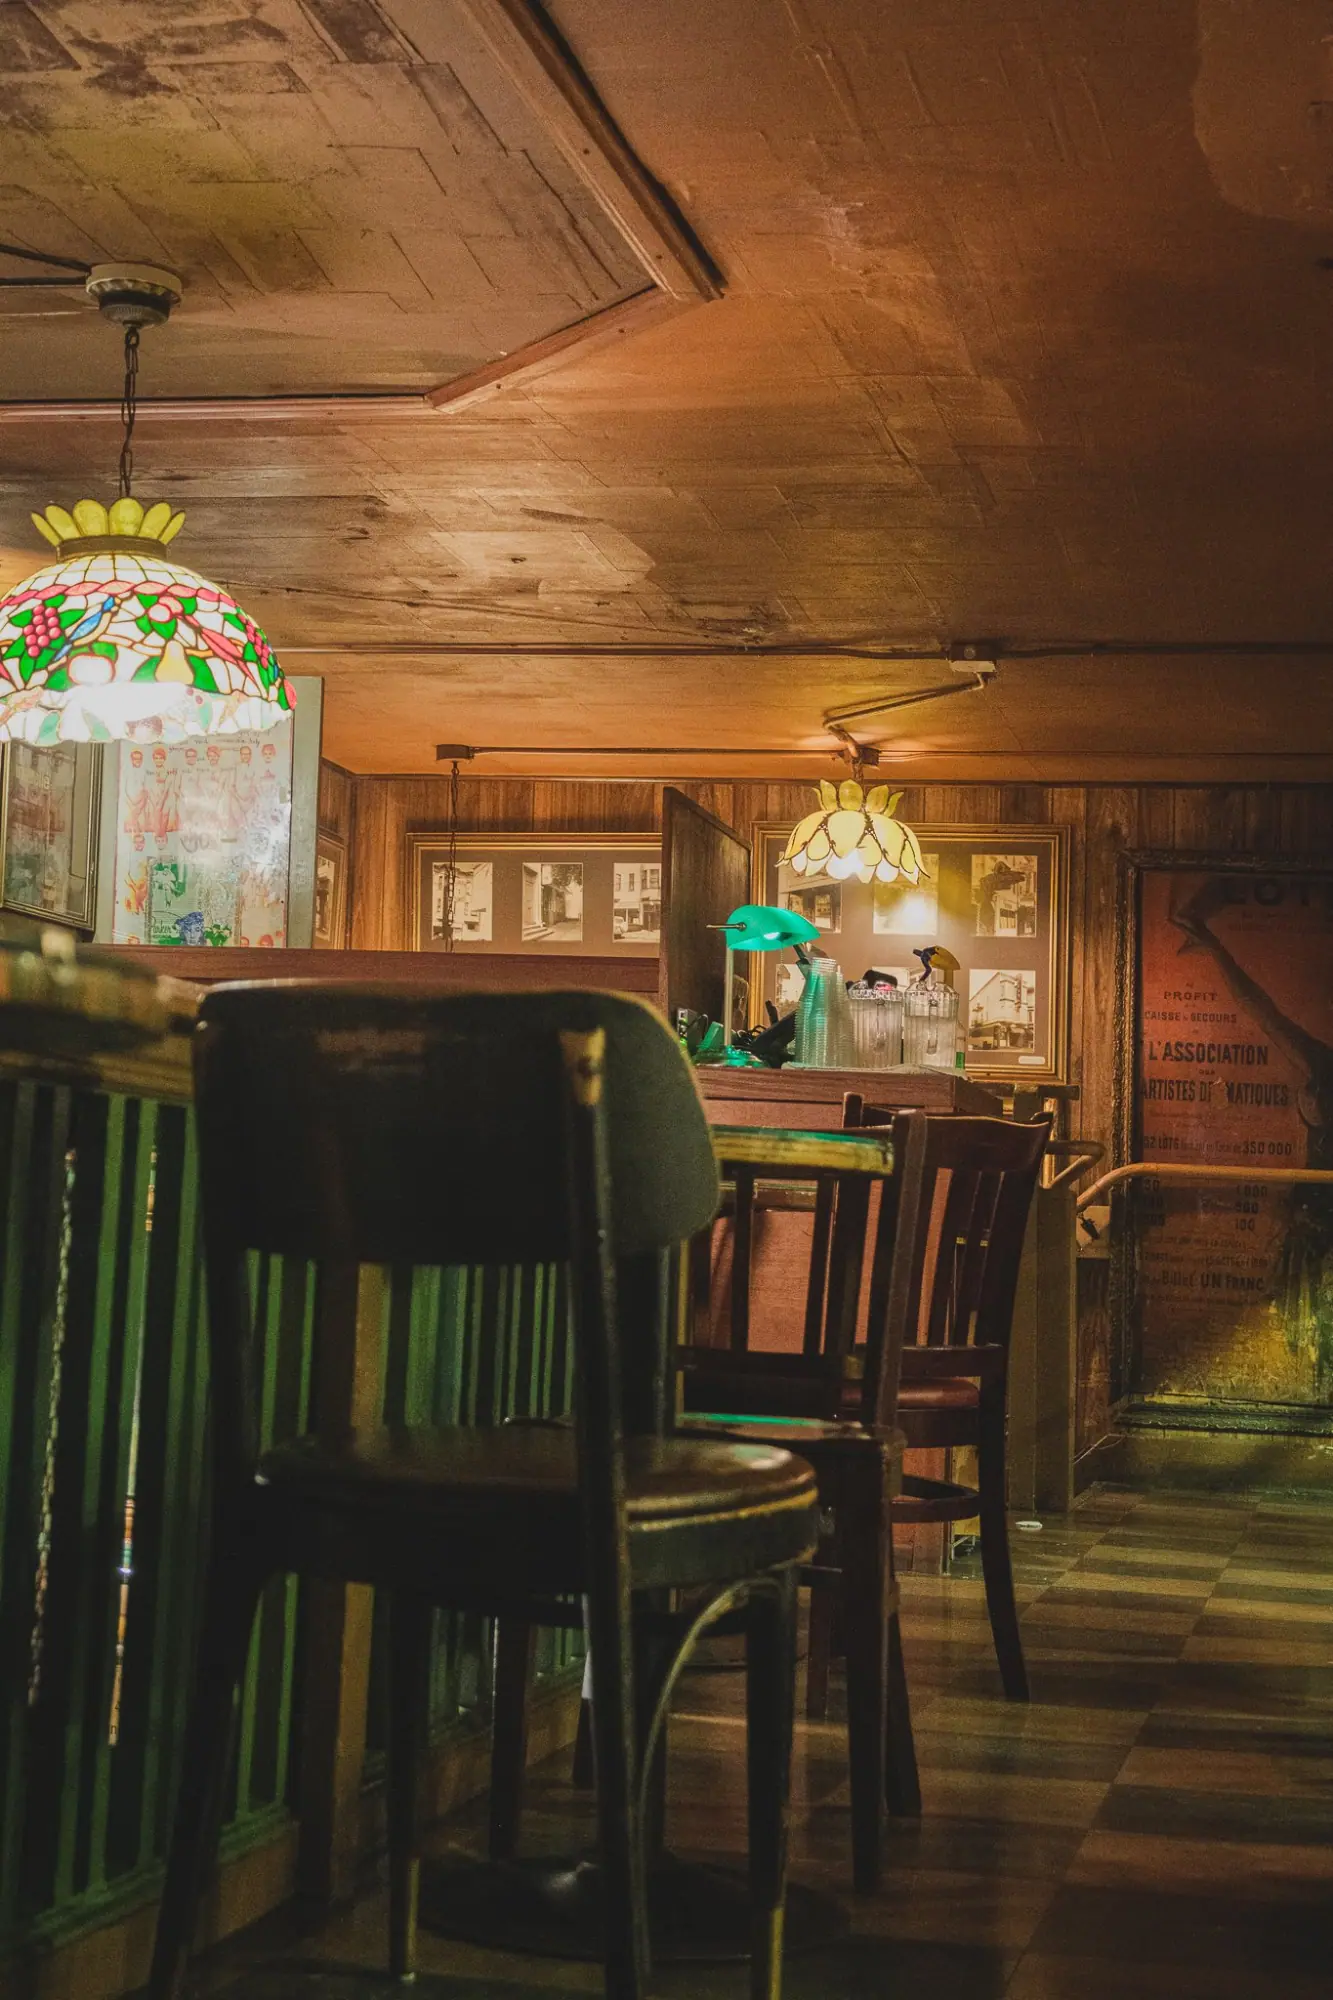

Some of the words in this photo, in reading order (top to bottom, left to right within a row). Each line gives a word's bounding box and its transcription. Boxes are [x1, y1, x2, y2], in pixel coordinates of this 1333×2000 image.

[1163, 990, 1218, 1001] PROFIT
[1144, 1011, 1181, 1021] CAISSE
[1190, 1012, 1237, 1024] SECOURS
[1148, 1040, 1268, 1066] L'ASSOCIATION
[1140, 1078, 1196, 1102] ARTISTES
